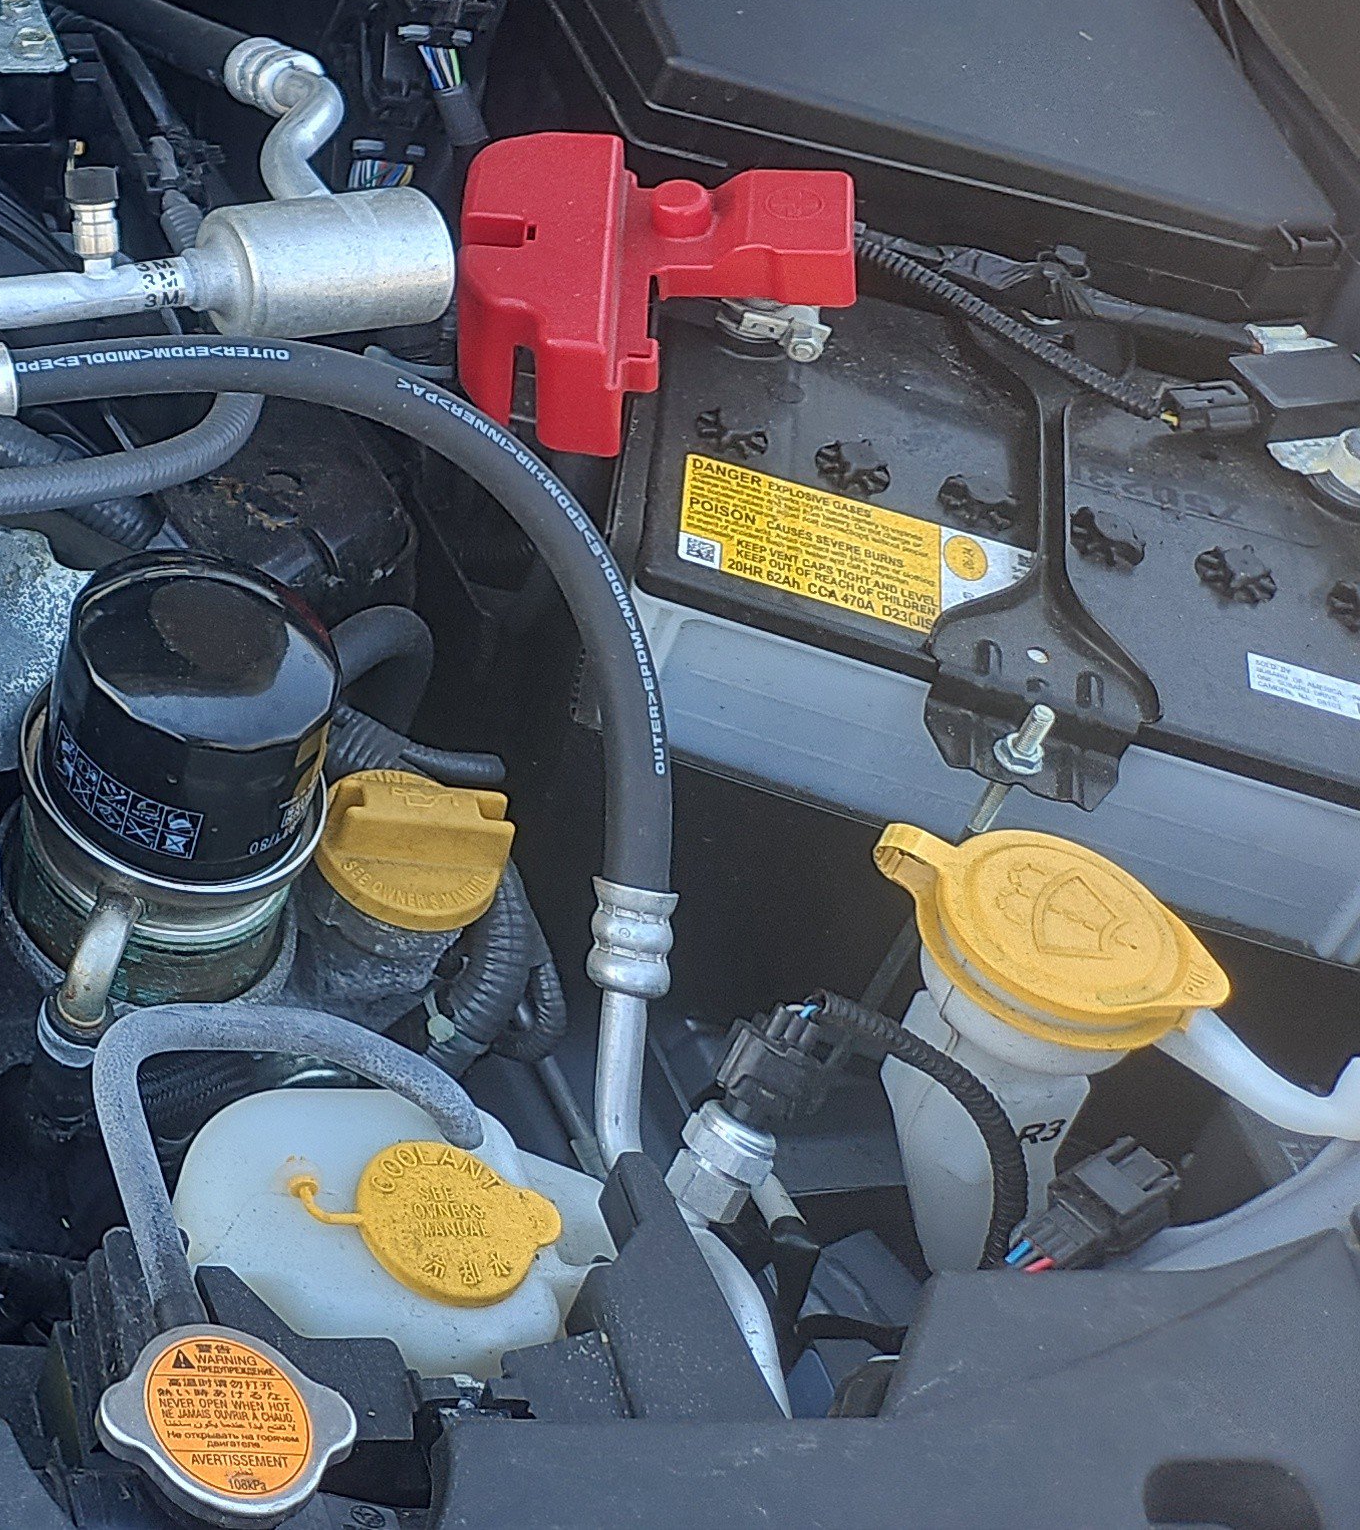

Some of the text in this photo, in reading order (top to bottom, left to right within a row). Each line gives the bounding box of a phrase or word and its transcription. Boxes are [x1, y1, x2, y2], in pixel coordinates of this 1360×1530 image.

[693, 458, 762, 487] DANGER
[768, 482, 830, 506] EXPLOSIVE
[833, 497, 872, 519] GASES
[689, 497, 757, 526] POISON
[766, 520, 813, 541] CAUSES
[816, 534, 862, 555] SEVERE
[864, 551, 905, 569] BURNS
[736, 538, 938, 608] KEEP VENT CAPS TIGHT AND LEVEL
[728, 558, 764, 578] 20HR
[766, 571, 801, 590] 62Ah
[807, 582, 839, 602] CCA
[841, 592, 875, 613] 470A
[735, 548, 937, 617] KEEP OUT OF REACH OF CHILDREN
[343, 860, 372, 886] SEE
[441, 874, 492, 906] MANUAL
[372, 1146, 503, 1193] COOLANT
[418, 1185, 456, 1202] SEE
[413, 1202, 486, 1220] OWNERS
[419, 1220, 491, 1237] MANUAL
[194, 1354, 258, 1366] WARNING
[197, 1365, 276, 1376] ПРЕДУПРЕЖДЕНИЕ
[158, 1398, 294, 1413] NEVER OPEN WHEN HOT.
[162, 1408, 174, 1418] NE
[178, 1409, 211, 1419] JAMAIS
[214, 1410, 249, 1421] OUVRIR
[261, 1412, 296, 1423] CHAUD.
[167, 1431, 182, 1439] Не
[185, 1431, 239, 1440] открывать
[257, 1434, 299, 1443] горячем
[191, 1454, 288, 1468] AVERTISSEMENT
[228, 1478, 267, 1491] 108kPa
